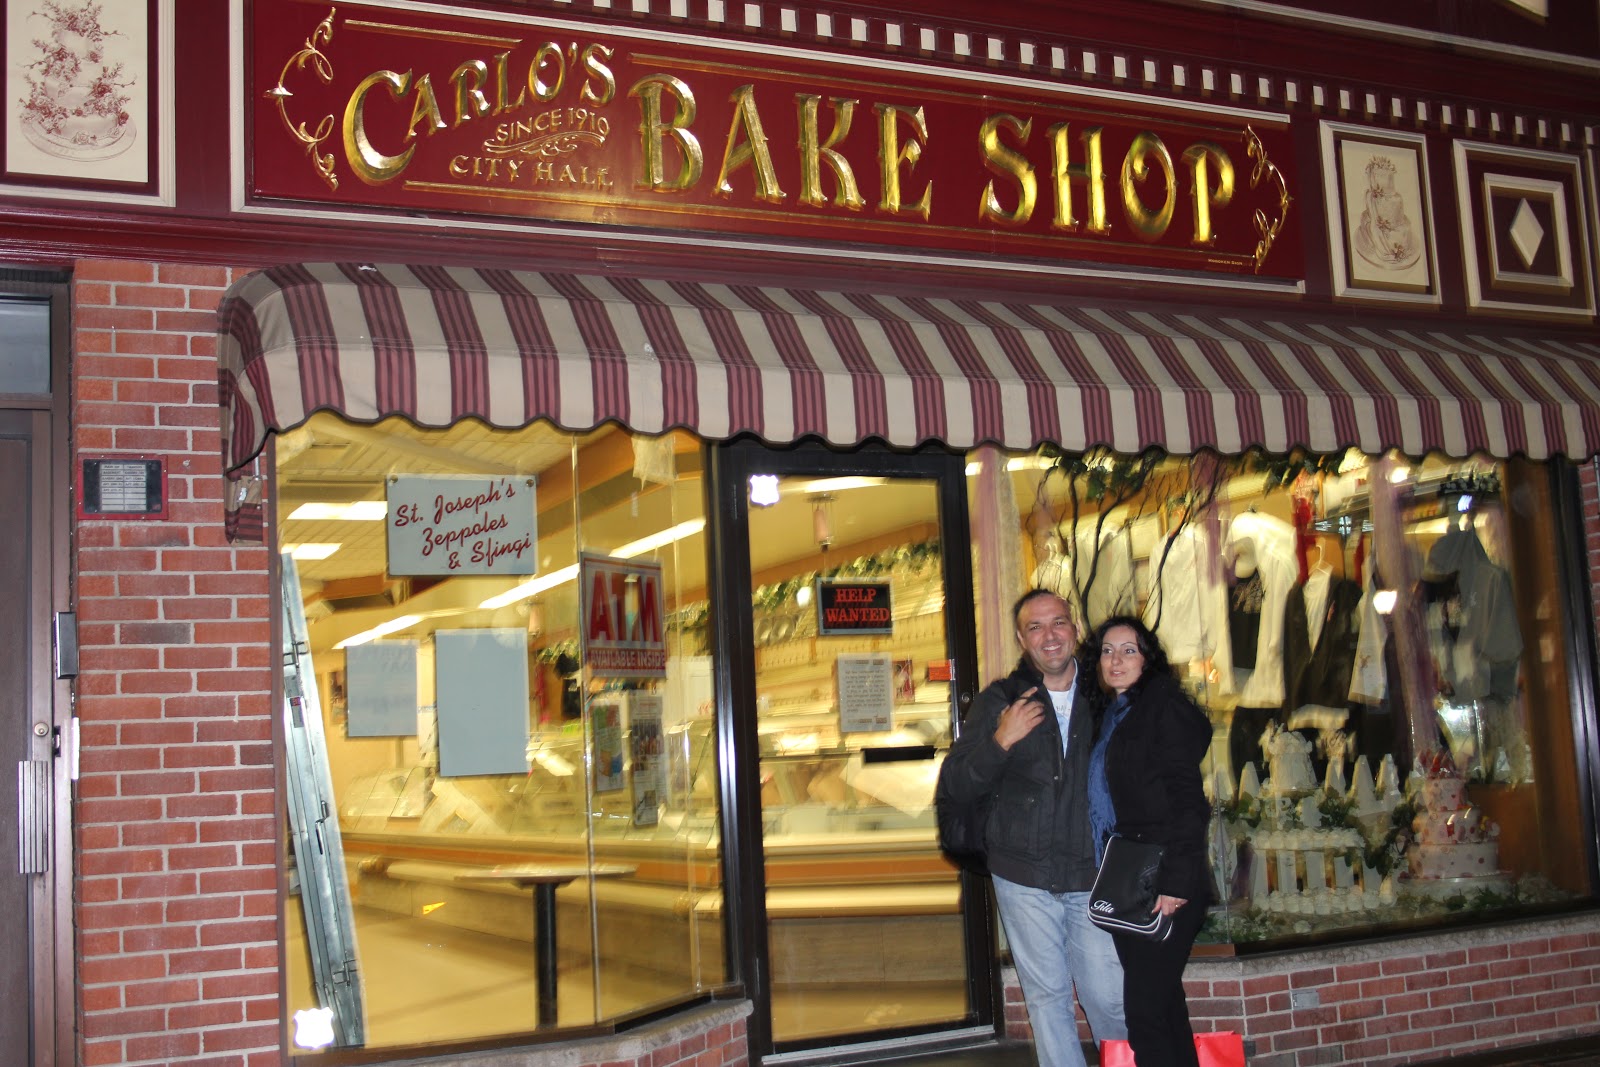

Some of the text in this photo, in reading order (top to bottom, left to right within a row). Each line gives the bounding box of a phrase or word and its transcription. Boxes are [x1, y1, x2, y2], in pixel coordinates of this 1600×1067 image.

[490, 108, 610, 143] SINCE 1910
[342, 41, 1236, 247] CARLO'S BAKE SHOP
[449, 156, 614, 187] CITY HALL
[394, 478, 516, 527] St. Joseph's
[422, 511, 509, 557] Zeppoles
[448, 532, 532, 570] & Sfingi
[590, 570, 662, 642] ATM
[836, 588, 877, 603] HELP
[825, 607, 890, 622] WANTED
[591, 650, 665, 668] AVAILABLE INSIDE
